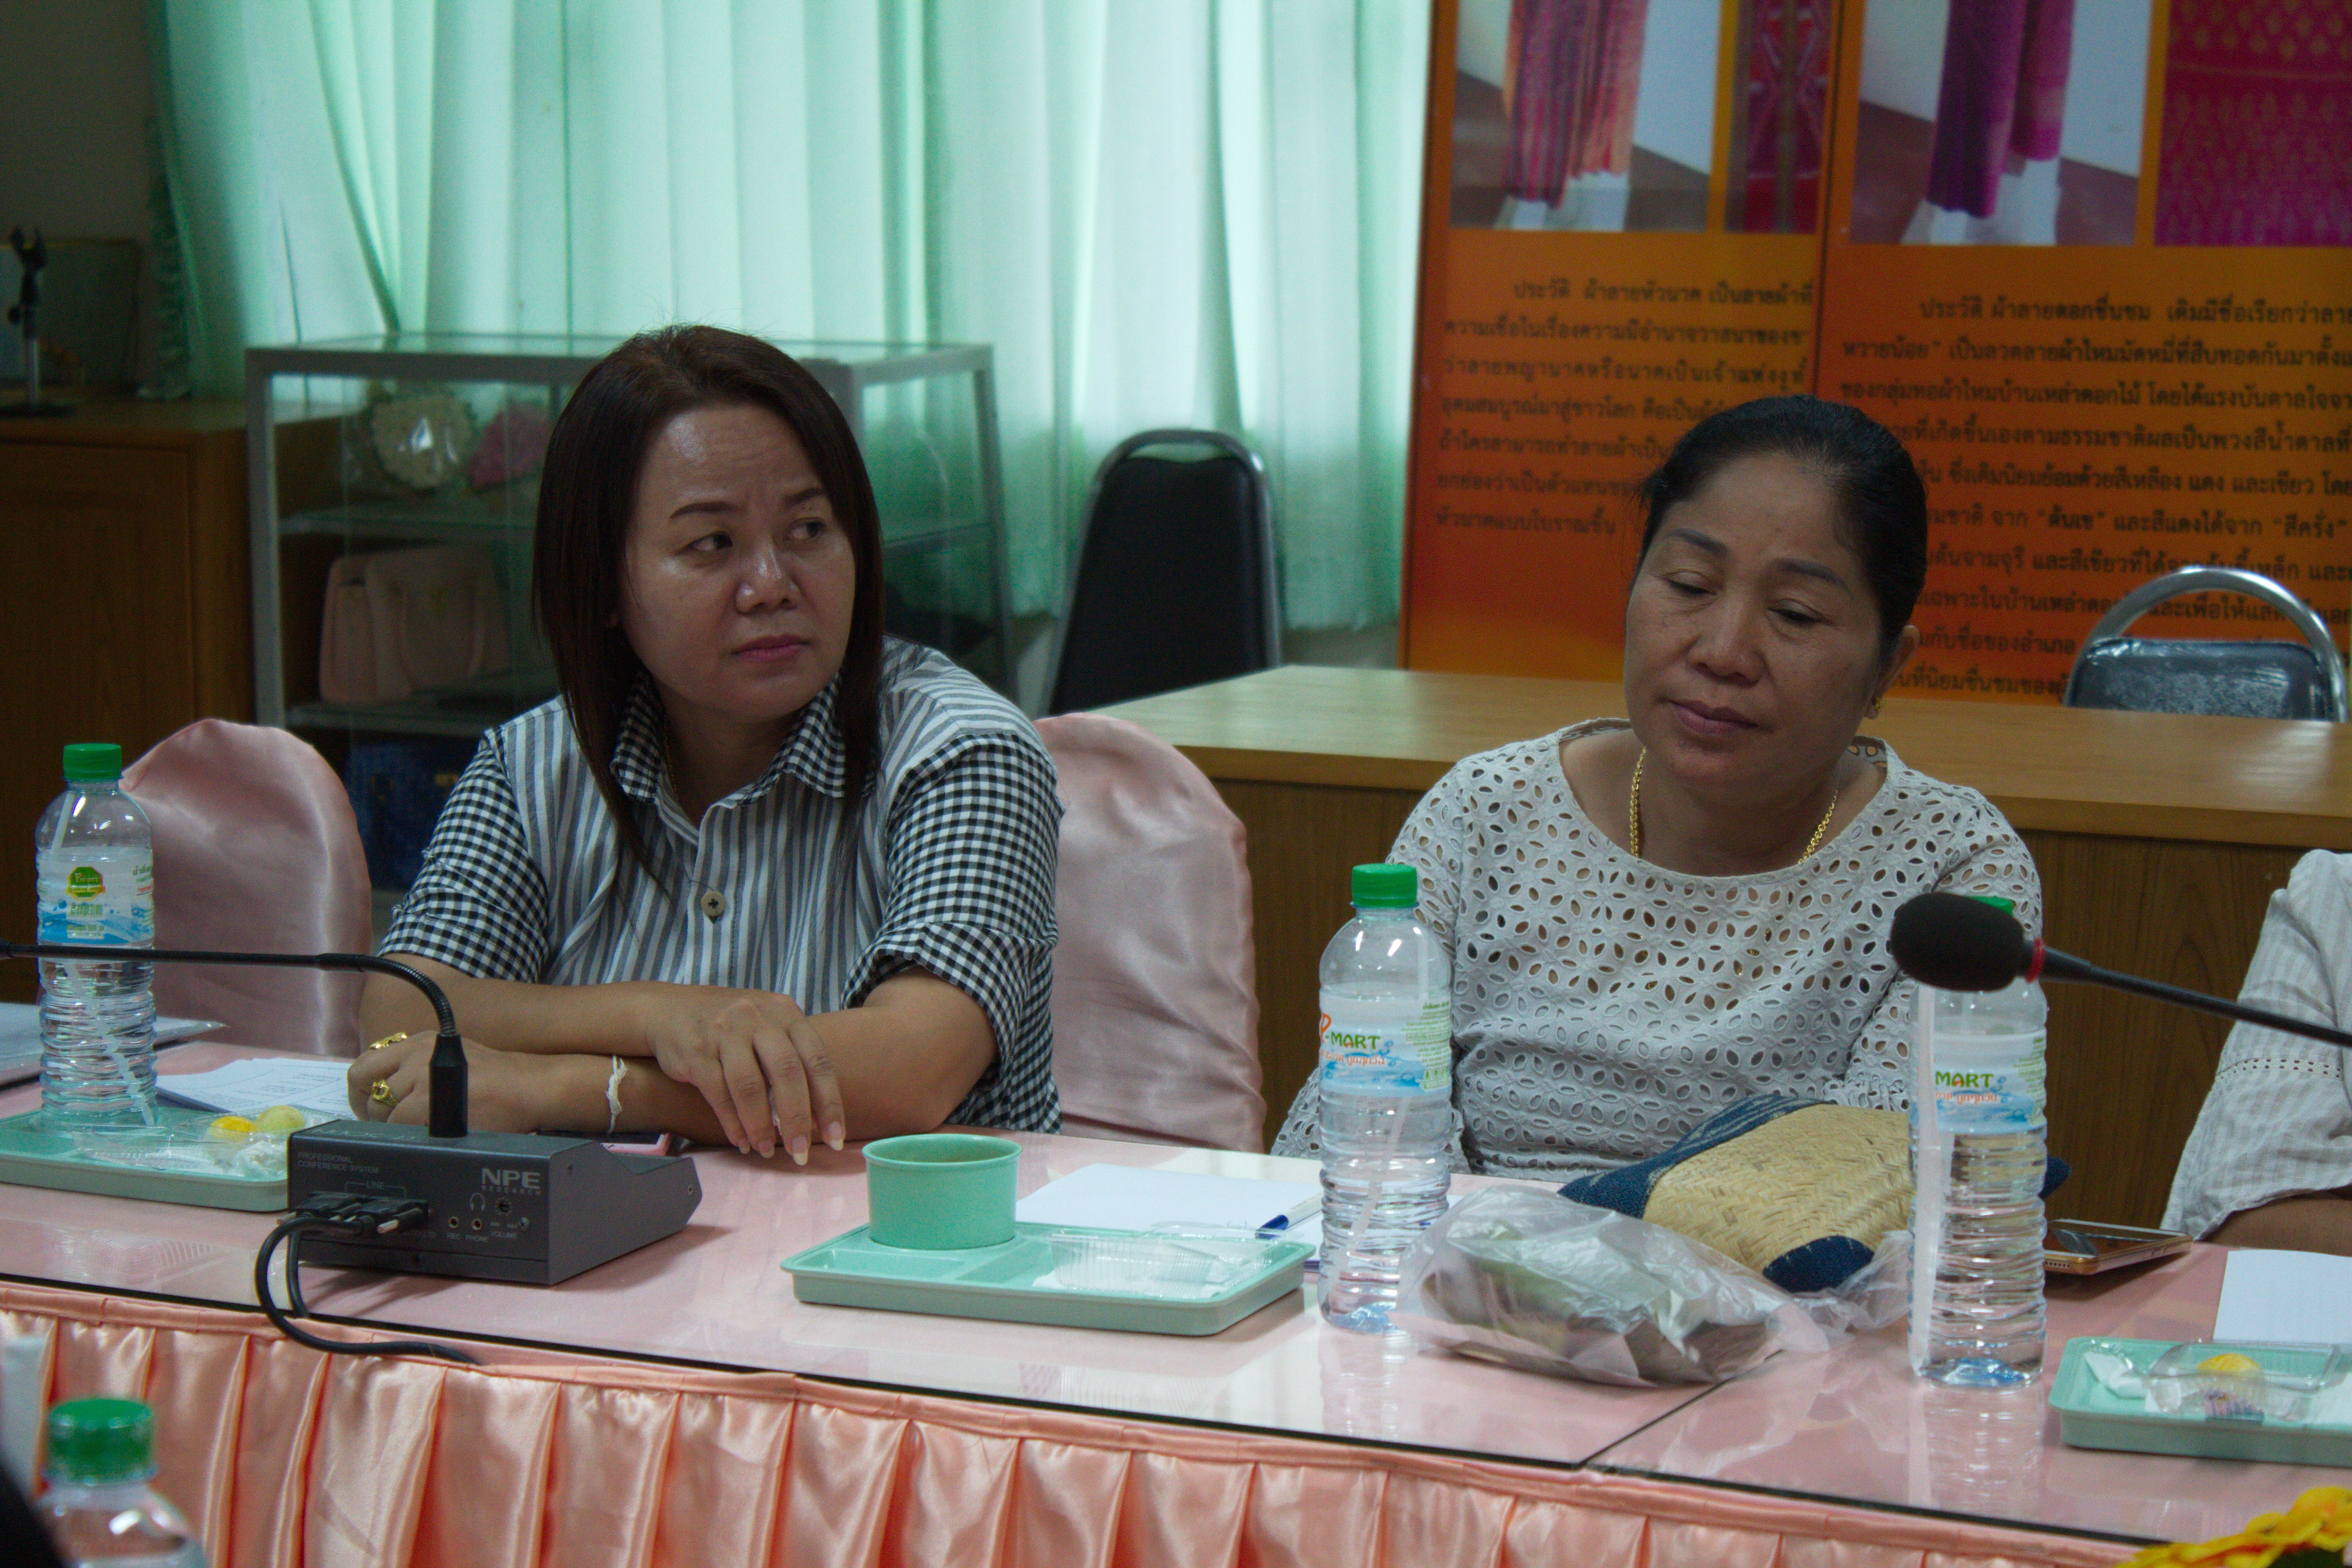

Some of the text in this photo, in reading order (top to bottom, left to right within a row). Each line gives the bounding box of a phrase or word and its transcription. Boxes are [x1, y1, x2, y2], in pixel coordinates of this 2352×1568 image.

[1514, 278, 1570, 300] ประวัติ
[1583, 278, 1702, 303] ผ้าลายหัวนาค
[1919, 294, 1983, 319] ประวัติ
[1992, 292, 2151, 322] ผ้าลายดอกชื่นชม
[2188, 474, 2225, 492] แดง
[2231, 470, 2315, 496] และเขียว
[1991, 509, 2028, 528] จาก
[297, 1151, 353, 1163] PROFESSIONAL
[297, 1160, 379, 1174] CONFERENCE SYSTEM
[481, 1168, 540, 1190] NPE
[481, 1185, 540, 1196] RESEARCH
[465, 1234, 488, 1242] PHONE
[490, 1231, 517, 1240] VOLUME
